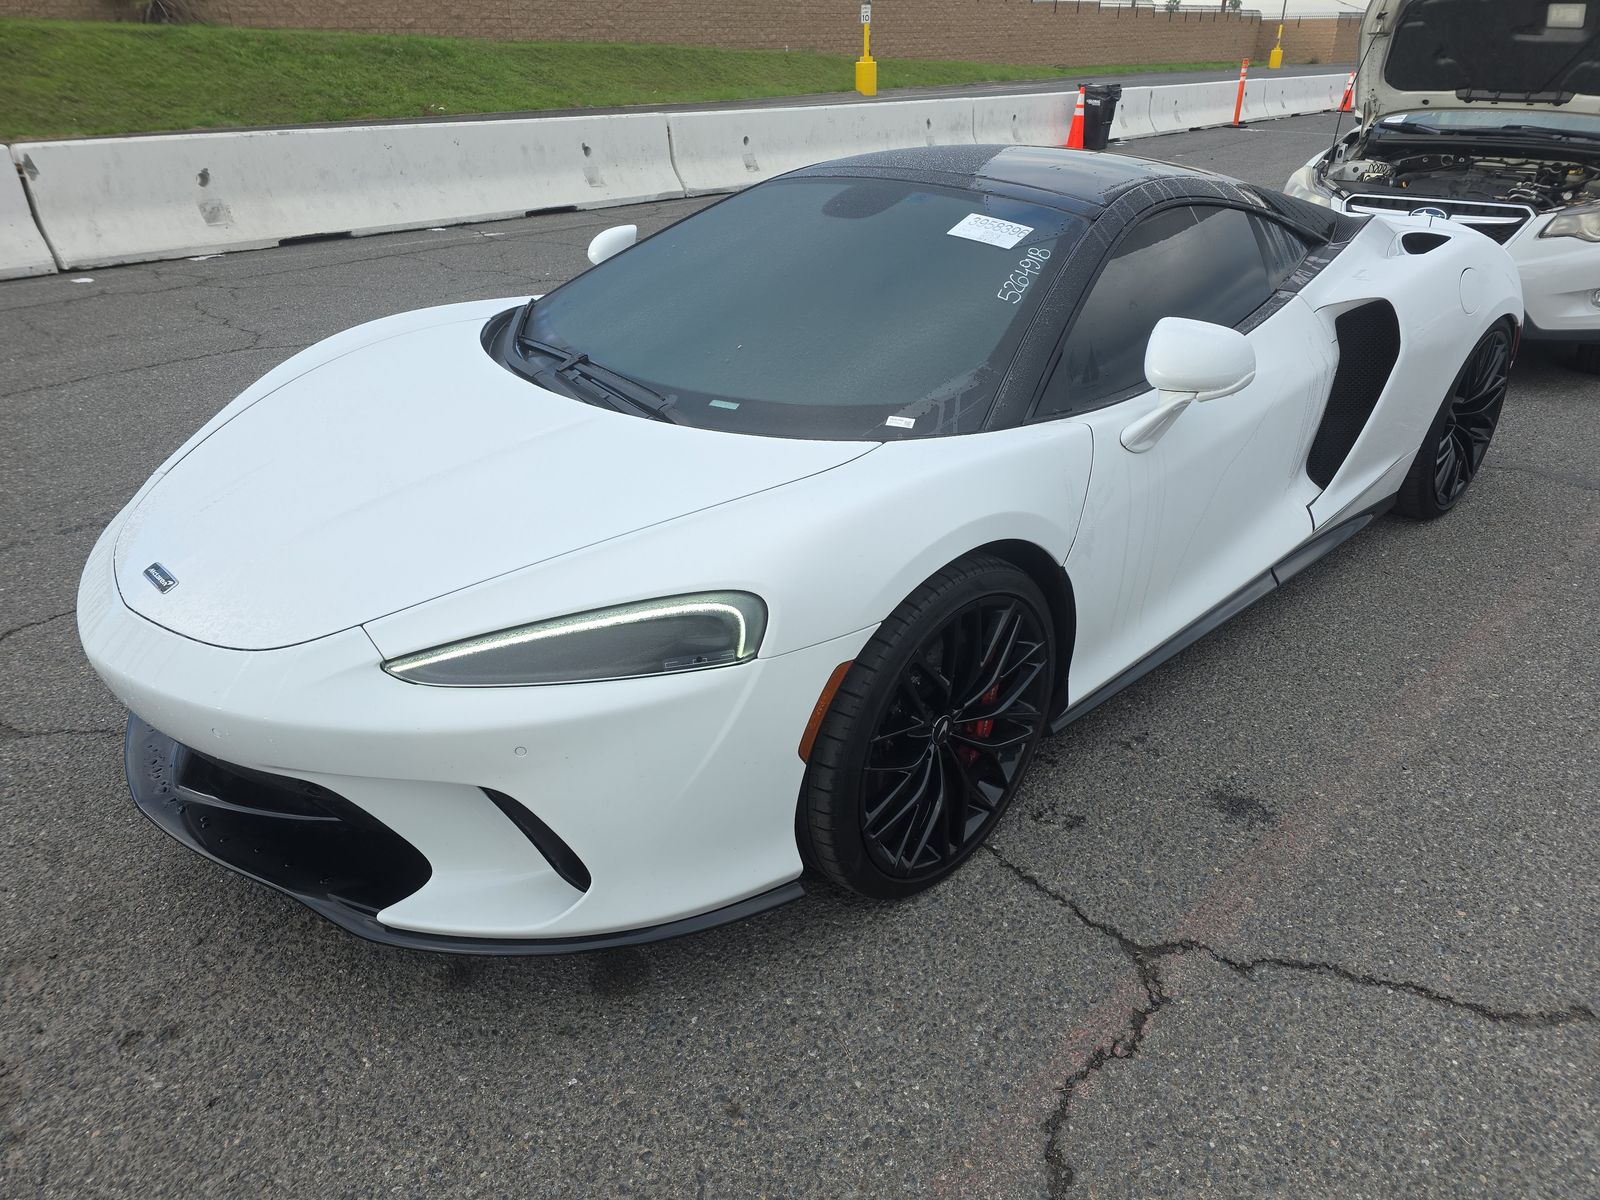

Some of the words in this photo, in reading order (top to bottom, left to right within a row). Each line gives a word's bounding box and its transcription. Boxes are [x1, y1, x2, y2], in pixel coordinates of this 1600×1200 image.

[862, 14, 870, 22] 10
[968, 216, 1030, 239] 3958396
[997, 247, 1051, 304] 5264918
